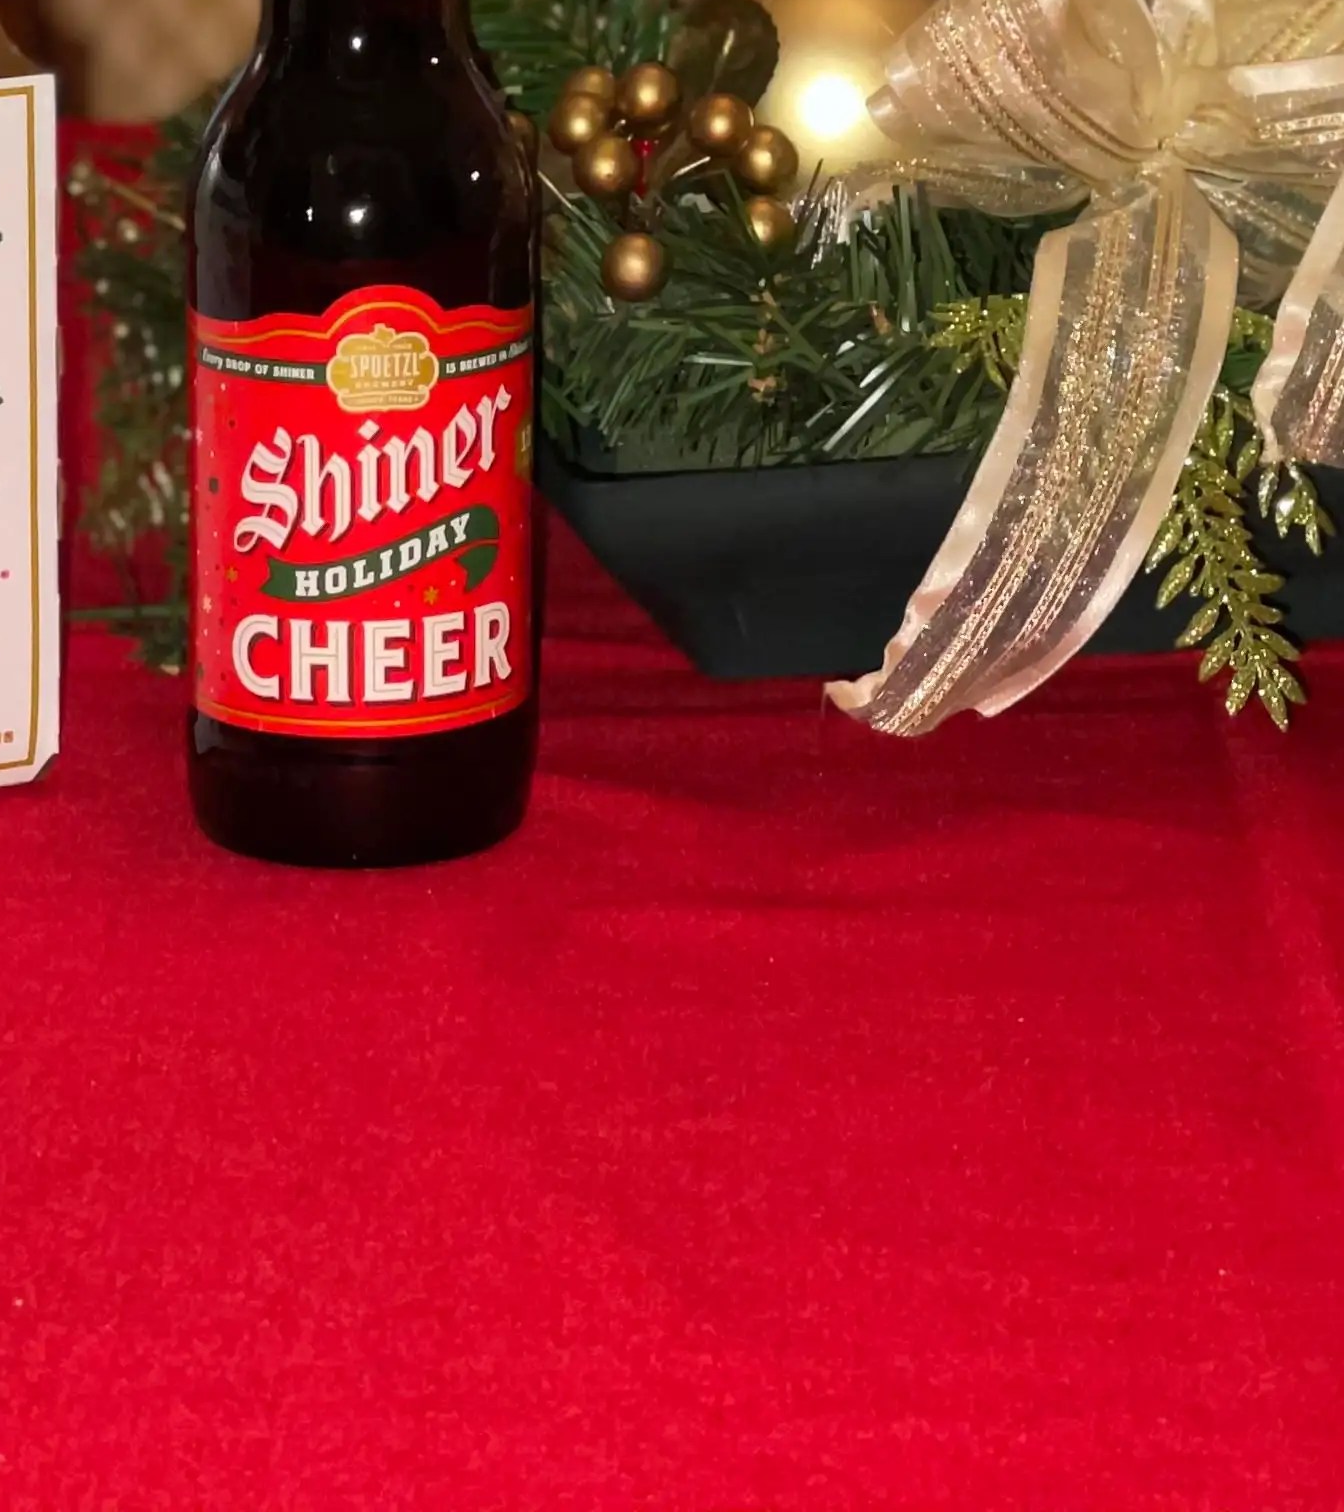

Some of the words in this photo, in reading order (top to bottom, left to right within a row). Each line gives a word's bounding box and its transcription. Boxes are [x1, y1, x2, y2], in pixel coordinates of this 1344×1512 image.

[225, 357, 251, 372] DROP
[255, 363, 269, 375] OF
[350, 352, 420, 378] SPOETZL
[446, 362, 456, 374] IS
[233, 383, 512, 554] Shiner
[295, 512, 471, 599] HOLIDAY
[231, 601, 514, 705] CHEER
